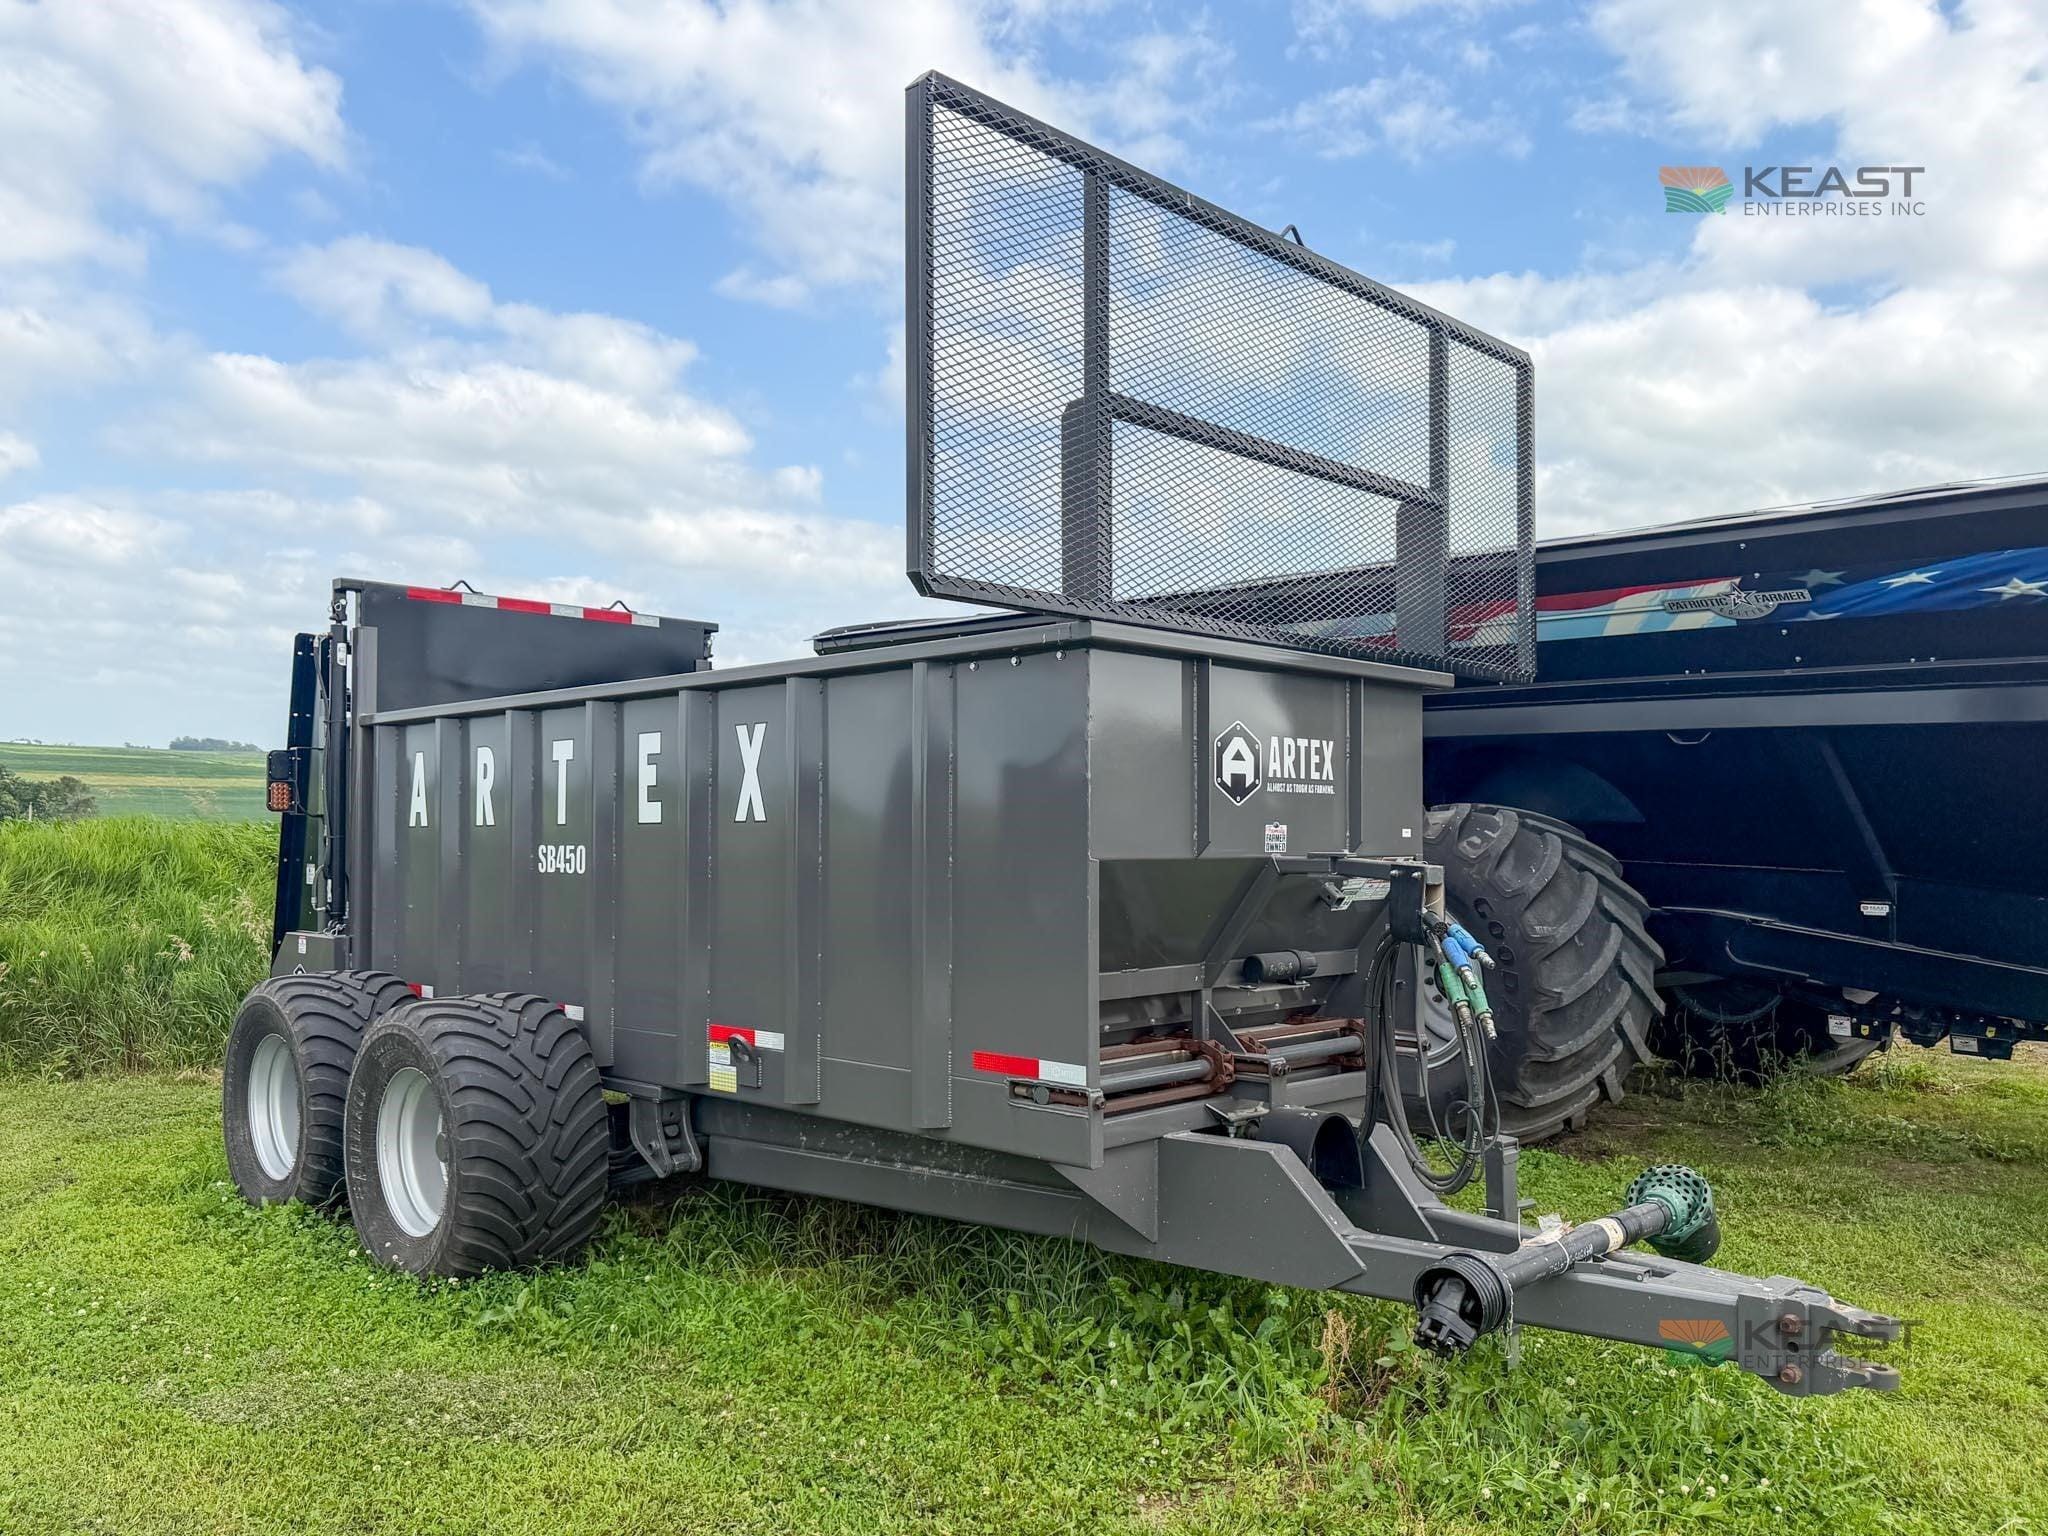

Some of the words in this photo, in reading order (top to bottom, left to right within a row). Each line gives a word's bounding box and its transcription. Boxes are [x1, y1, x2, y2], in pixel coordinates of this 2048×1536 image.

[1668, 597, 1728, 611] PATRIOTIC
[1754, 591, 1806, 603] FARMER
[1268, 736, 1334, 780] ARTEX
[537, 844, 587, 875] SB450
